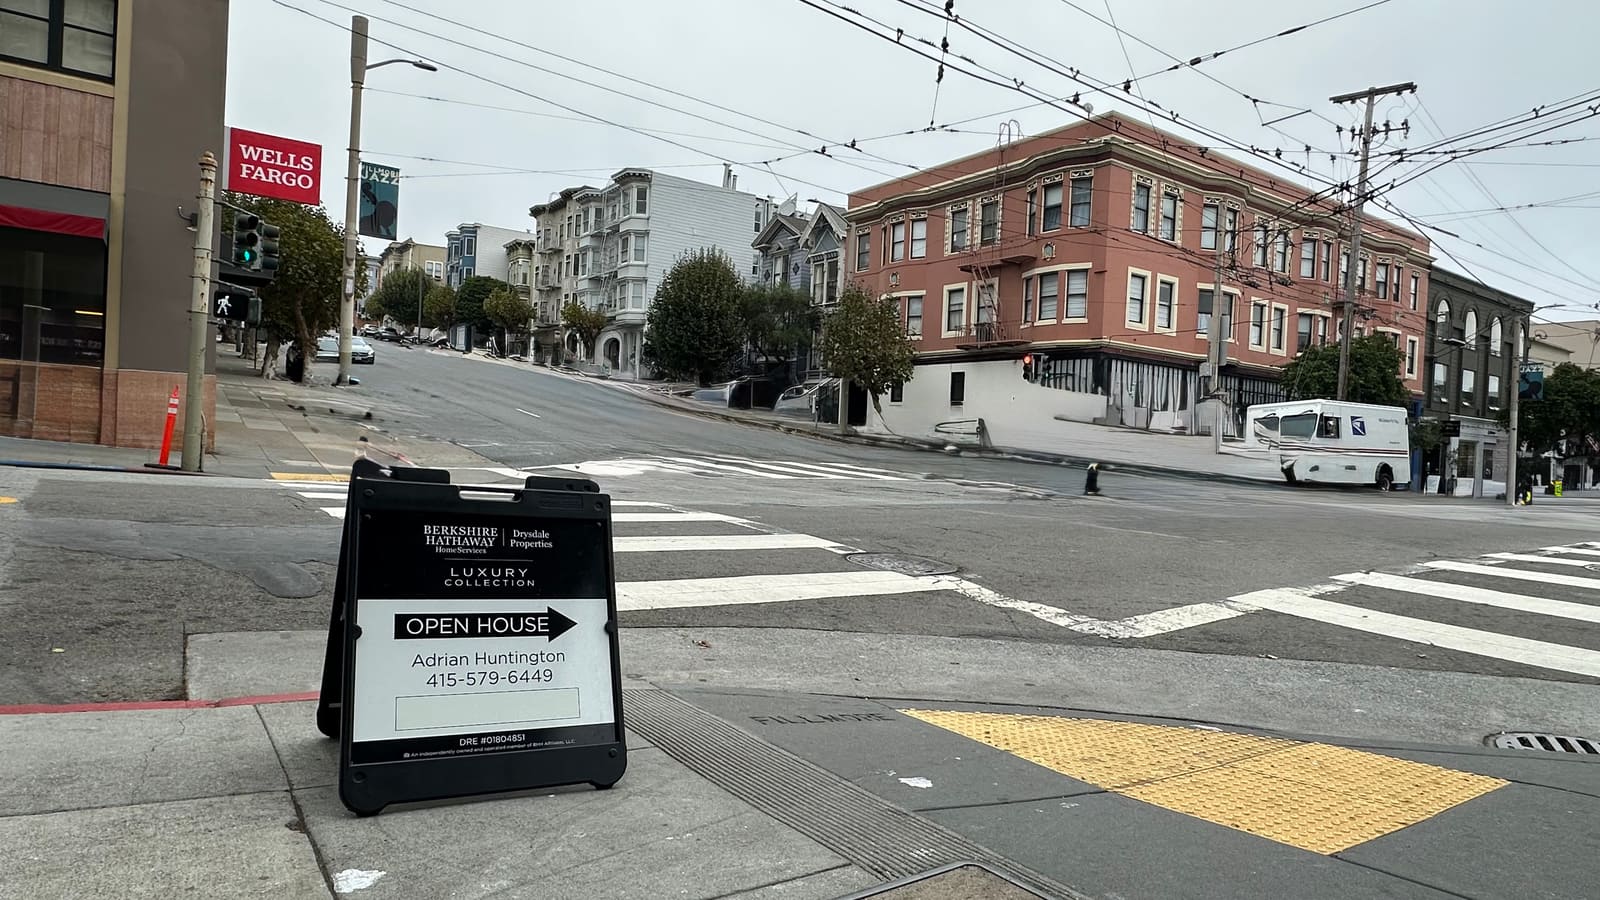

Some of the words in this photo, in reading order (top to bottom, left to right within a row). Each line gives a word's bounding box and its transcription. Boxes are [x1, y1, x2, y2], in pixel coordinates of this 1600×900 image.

[239, 144, 314, 171] WELLS
[240, 163, 314, 189] FARGO
[361, 165, 400, 185] JAZZ
[423, 525, 498, 537] BERKSHIRE
[513, 529, 550, 540] Drysdale
[426, 535, 496, 548] HATHAWAY
[510, 539, 553, 550] Properties
[435, 546, 487, 554] HomeServices
[450, 567, 528, 577] LUXURY
[444, 579, 535, 587] COLLECTION
[406, 617, 469, 635] OPEN
[477, 616, 550, 633] HOUSE
[411, 652, 469, 668] Adrian
[475, 650, 565, 666] Huntington
[426, 669, 553, 688] 415-579-6449
[459, 737, 478, 747] DRE
[480, 733, 526, 745] #01804851
